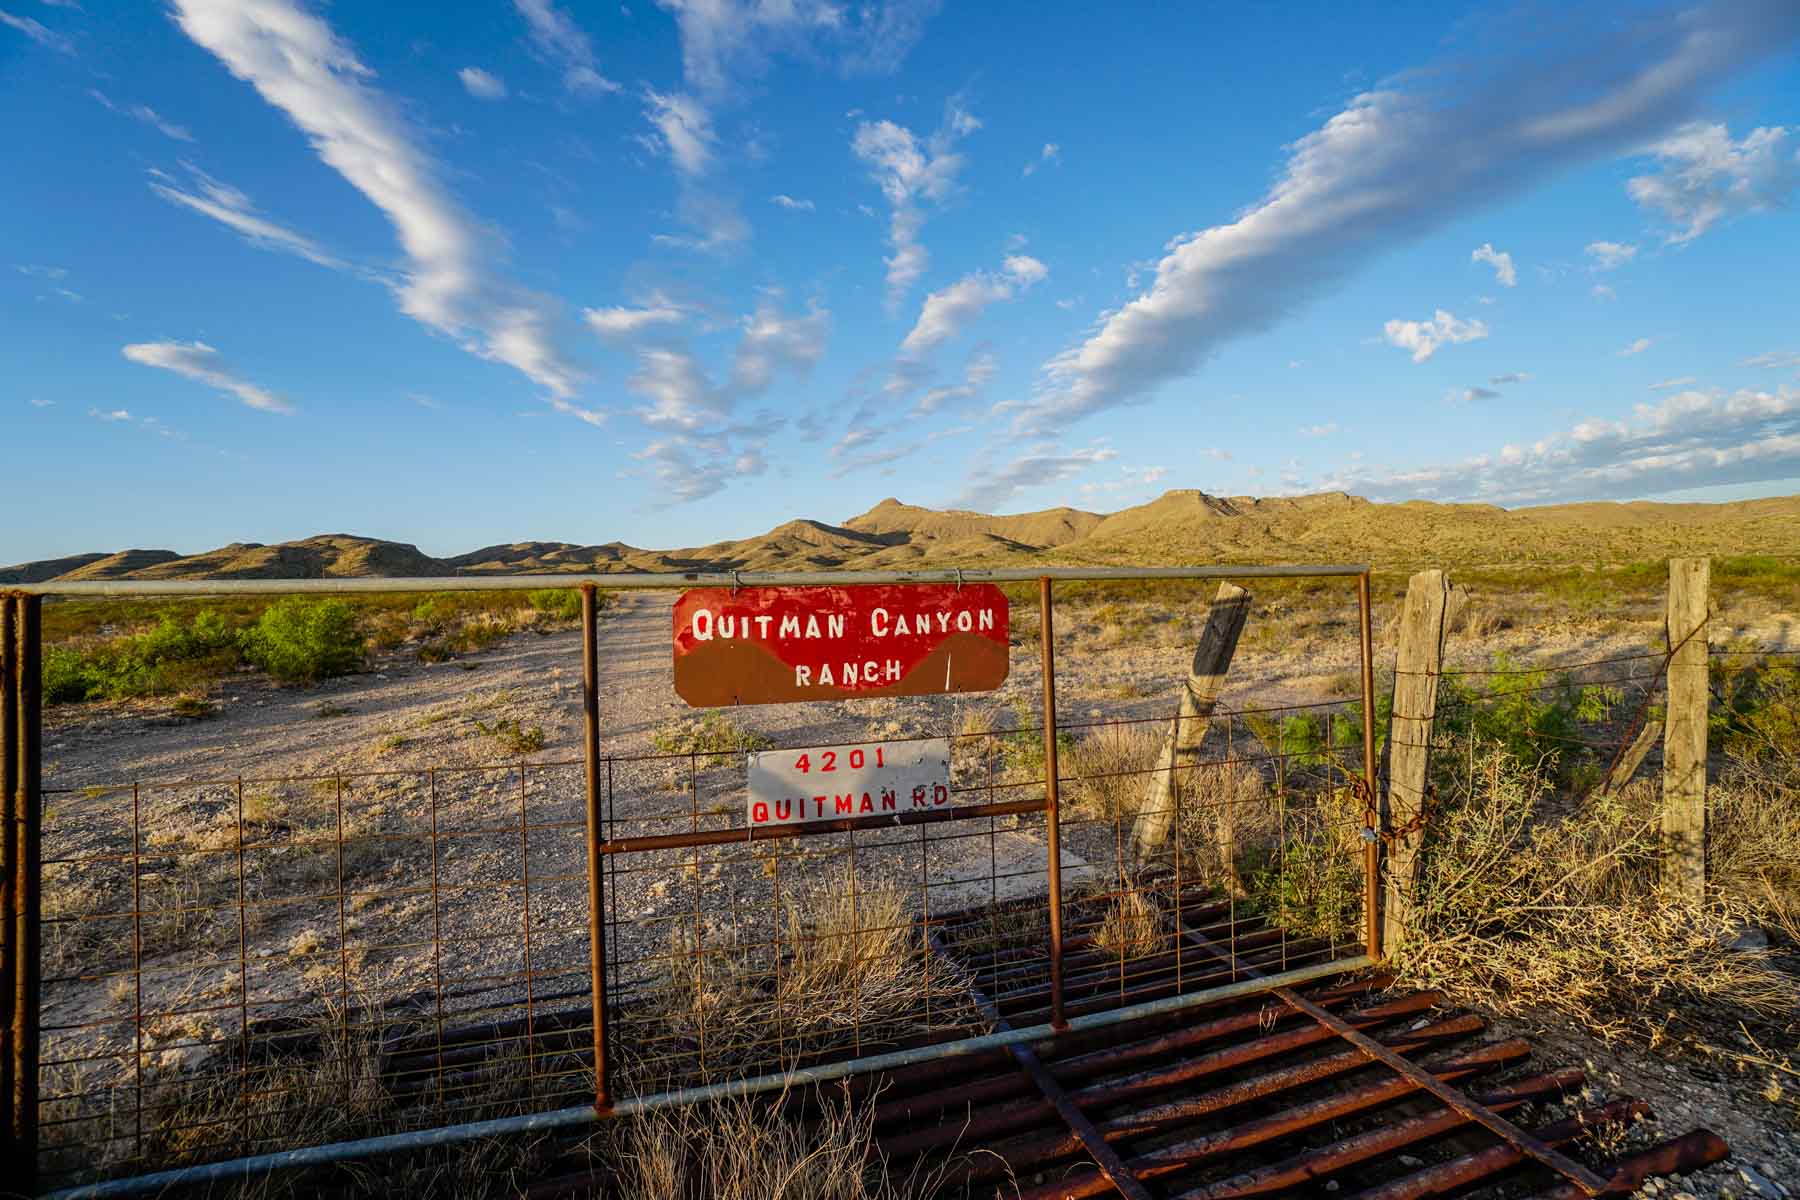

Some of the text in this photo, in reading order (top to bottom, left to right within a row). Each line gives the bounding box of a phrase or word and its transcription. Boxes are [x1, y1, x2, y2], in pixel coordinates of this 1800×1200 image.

[691, 607, 994, 641] QUITMAN CANYON
[795, 659, 901, 687] RANCH
[795, 747, 885, 774] 4201
[752, 785, 948, 823] QUITMAN RD
